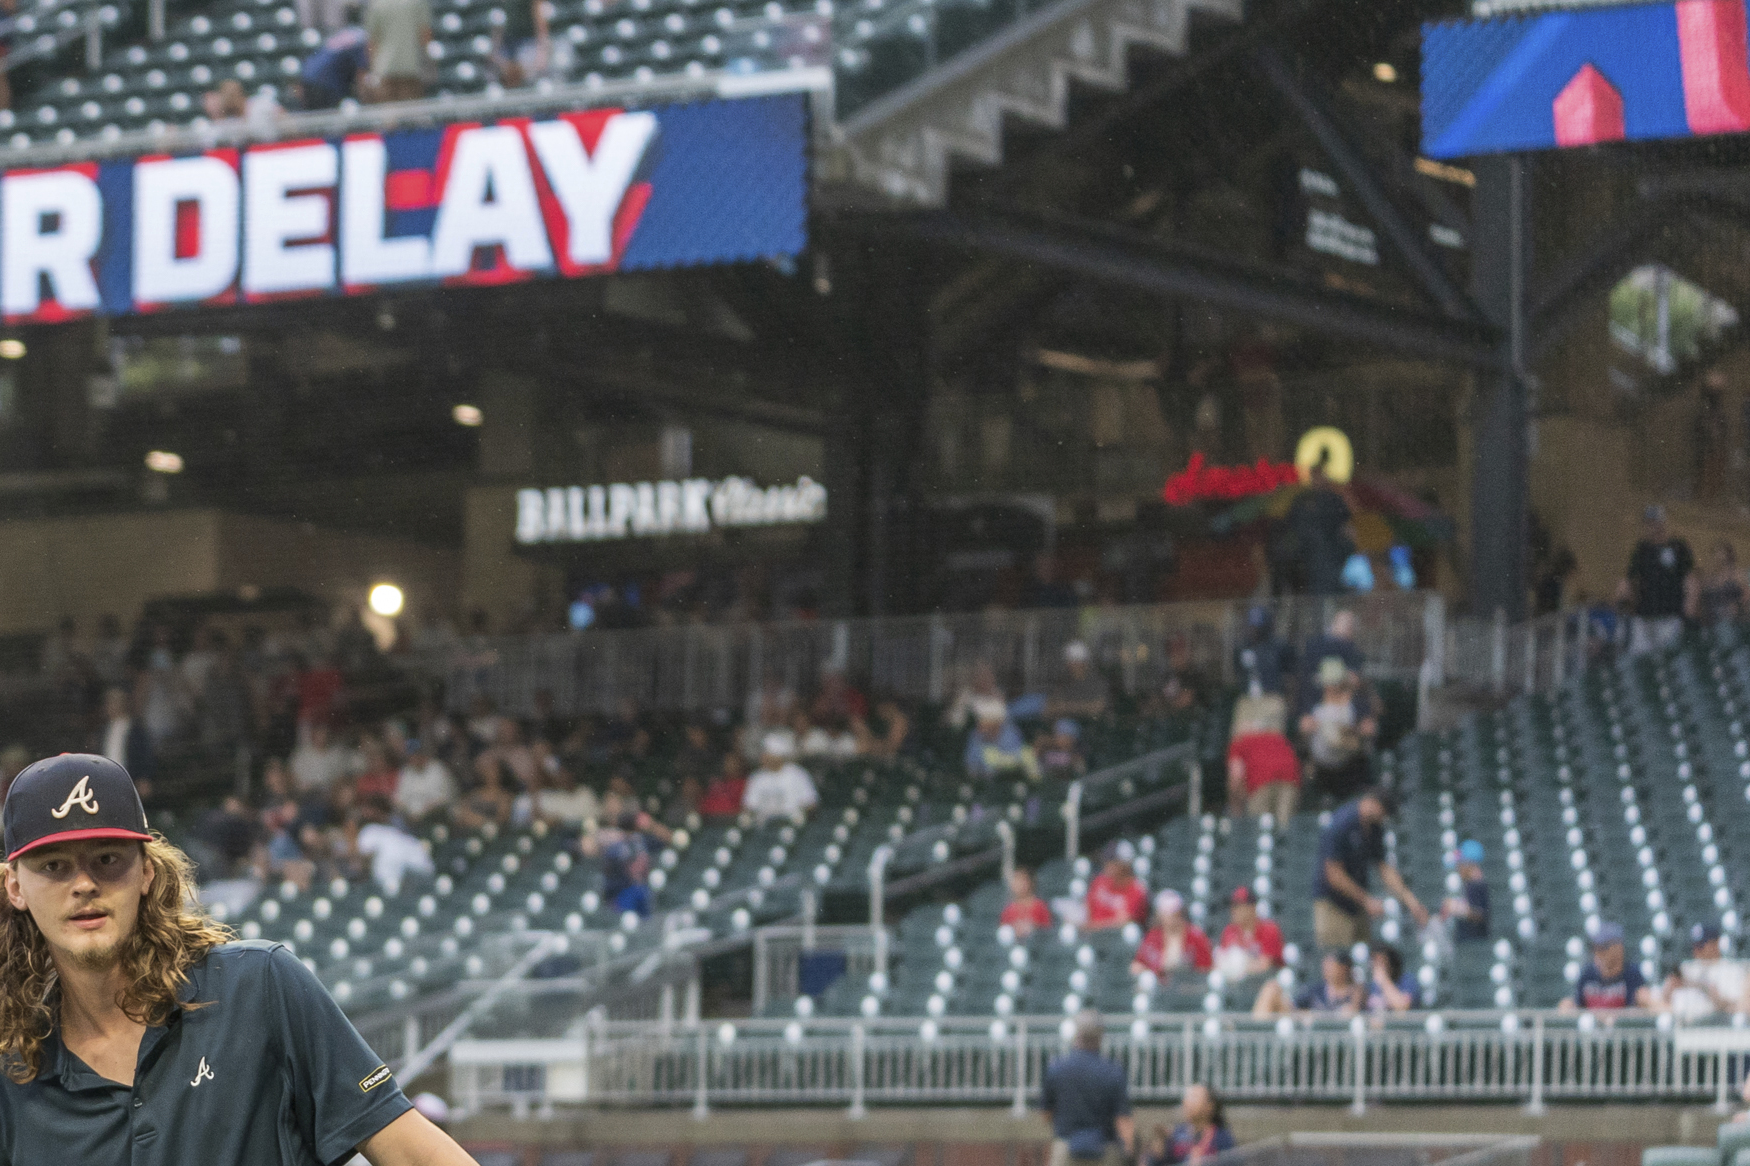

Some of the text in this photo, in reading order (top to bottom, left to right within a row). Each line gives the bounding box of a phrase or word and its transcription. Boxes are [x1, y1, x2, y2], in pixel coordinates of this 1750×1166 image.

[132, 110, 658, 304] DELAY
[516, 478, 711, 544] BALLPARK
[51, 775, 100, 819] A
[190, 1056, 214, 1087] A
